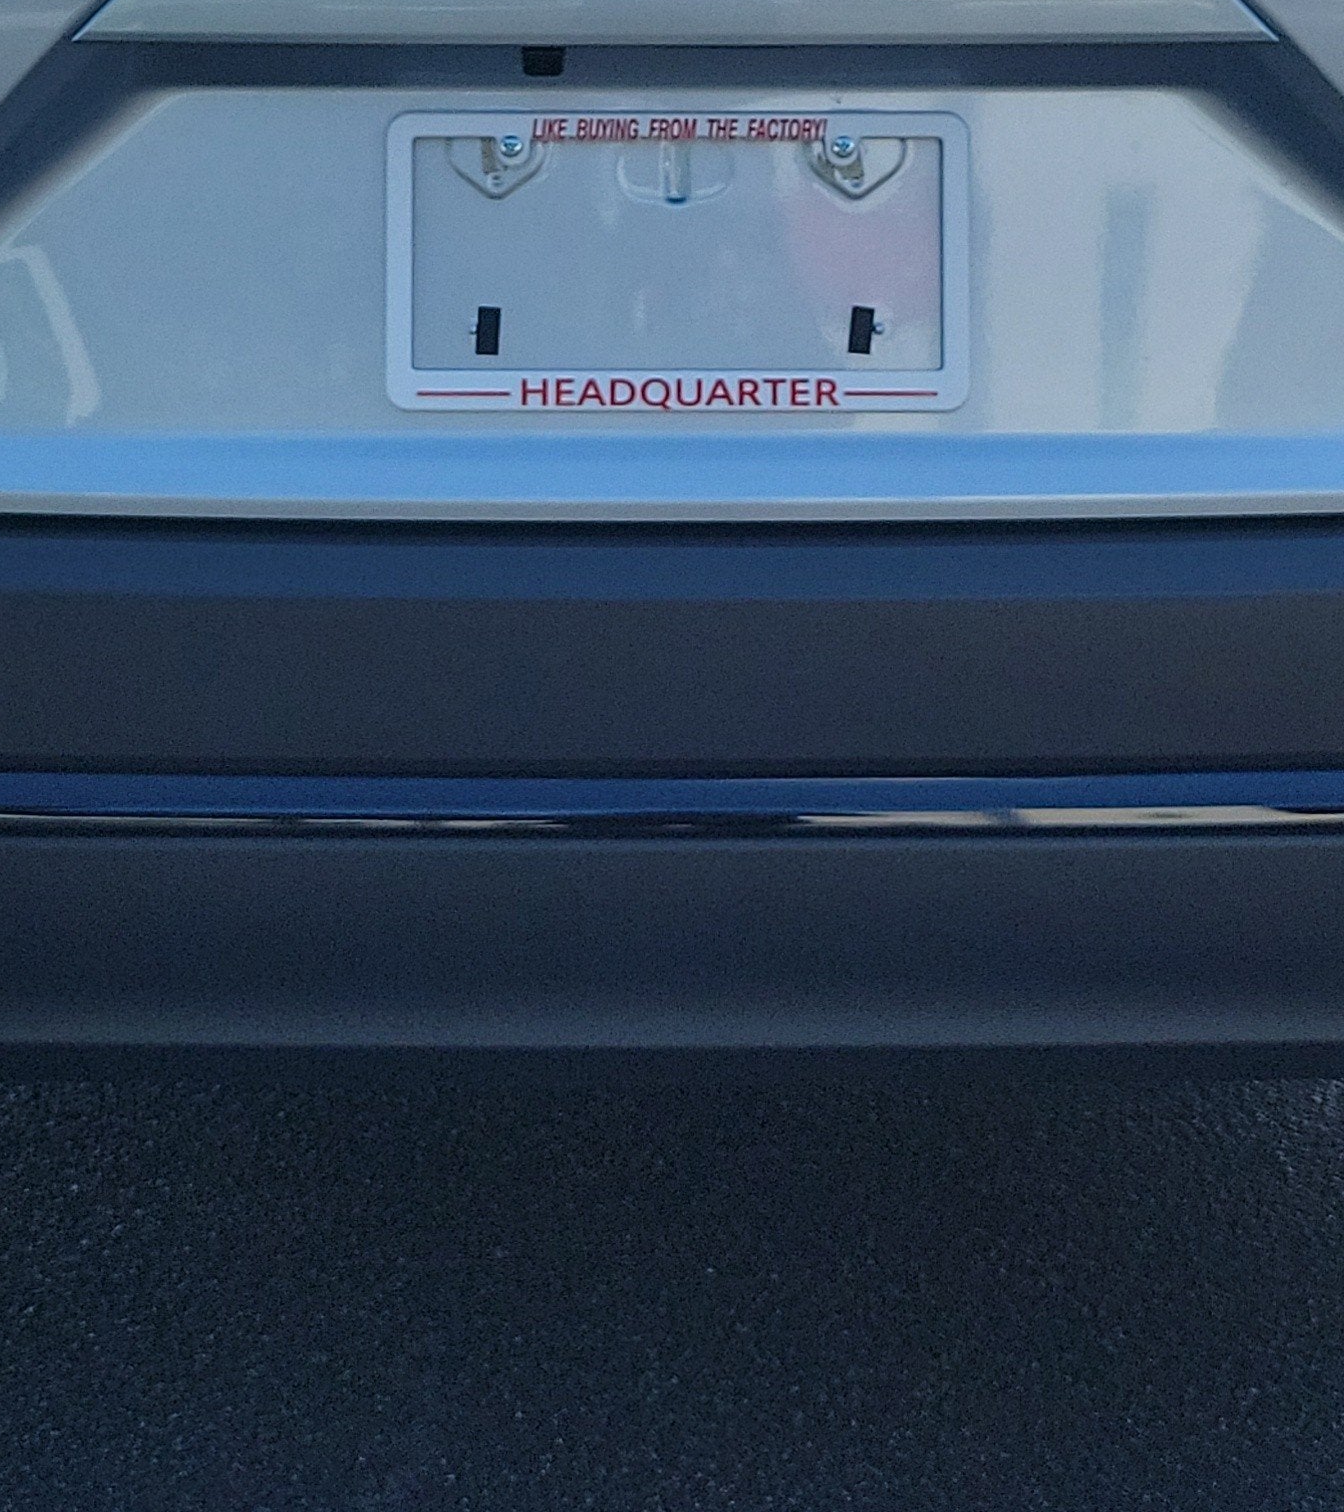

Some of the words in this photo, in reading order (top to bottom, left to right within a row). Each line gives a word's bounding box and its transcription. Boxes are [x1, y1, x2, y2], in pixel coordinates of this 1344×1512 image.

[531, 118, 568, 140] LIKE
[576, 118, 639, 140] BUYING
[649, 118, 697, 140] FROM
[707, 118, 739, 140] THE
[748, 118, 828, 141] FACTORY!
[520, 378, 839, 410] HEADQUARTER
